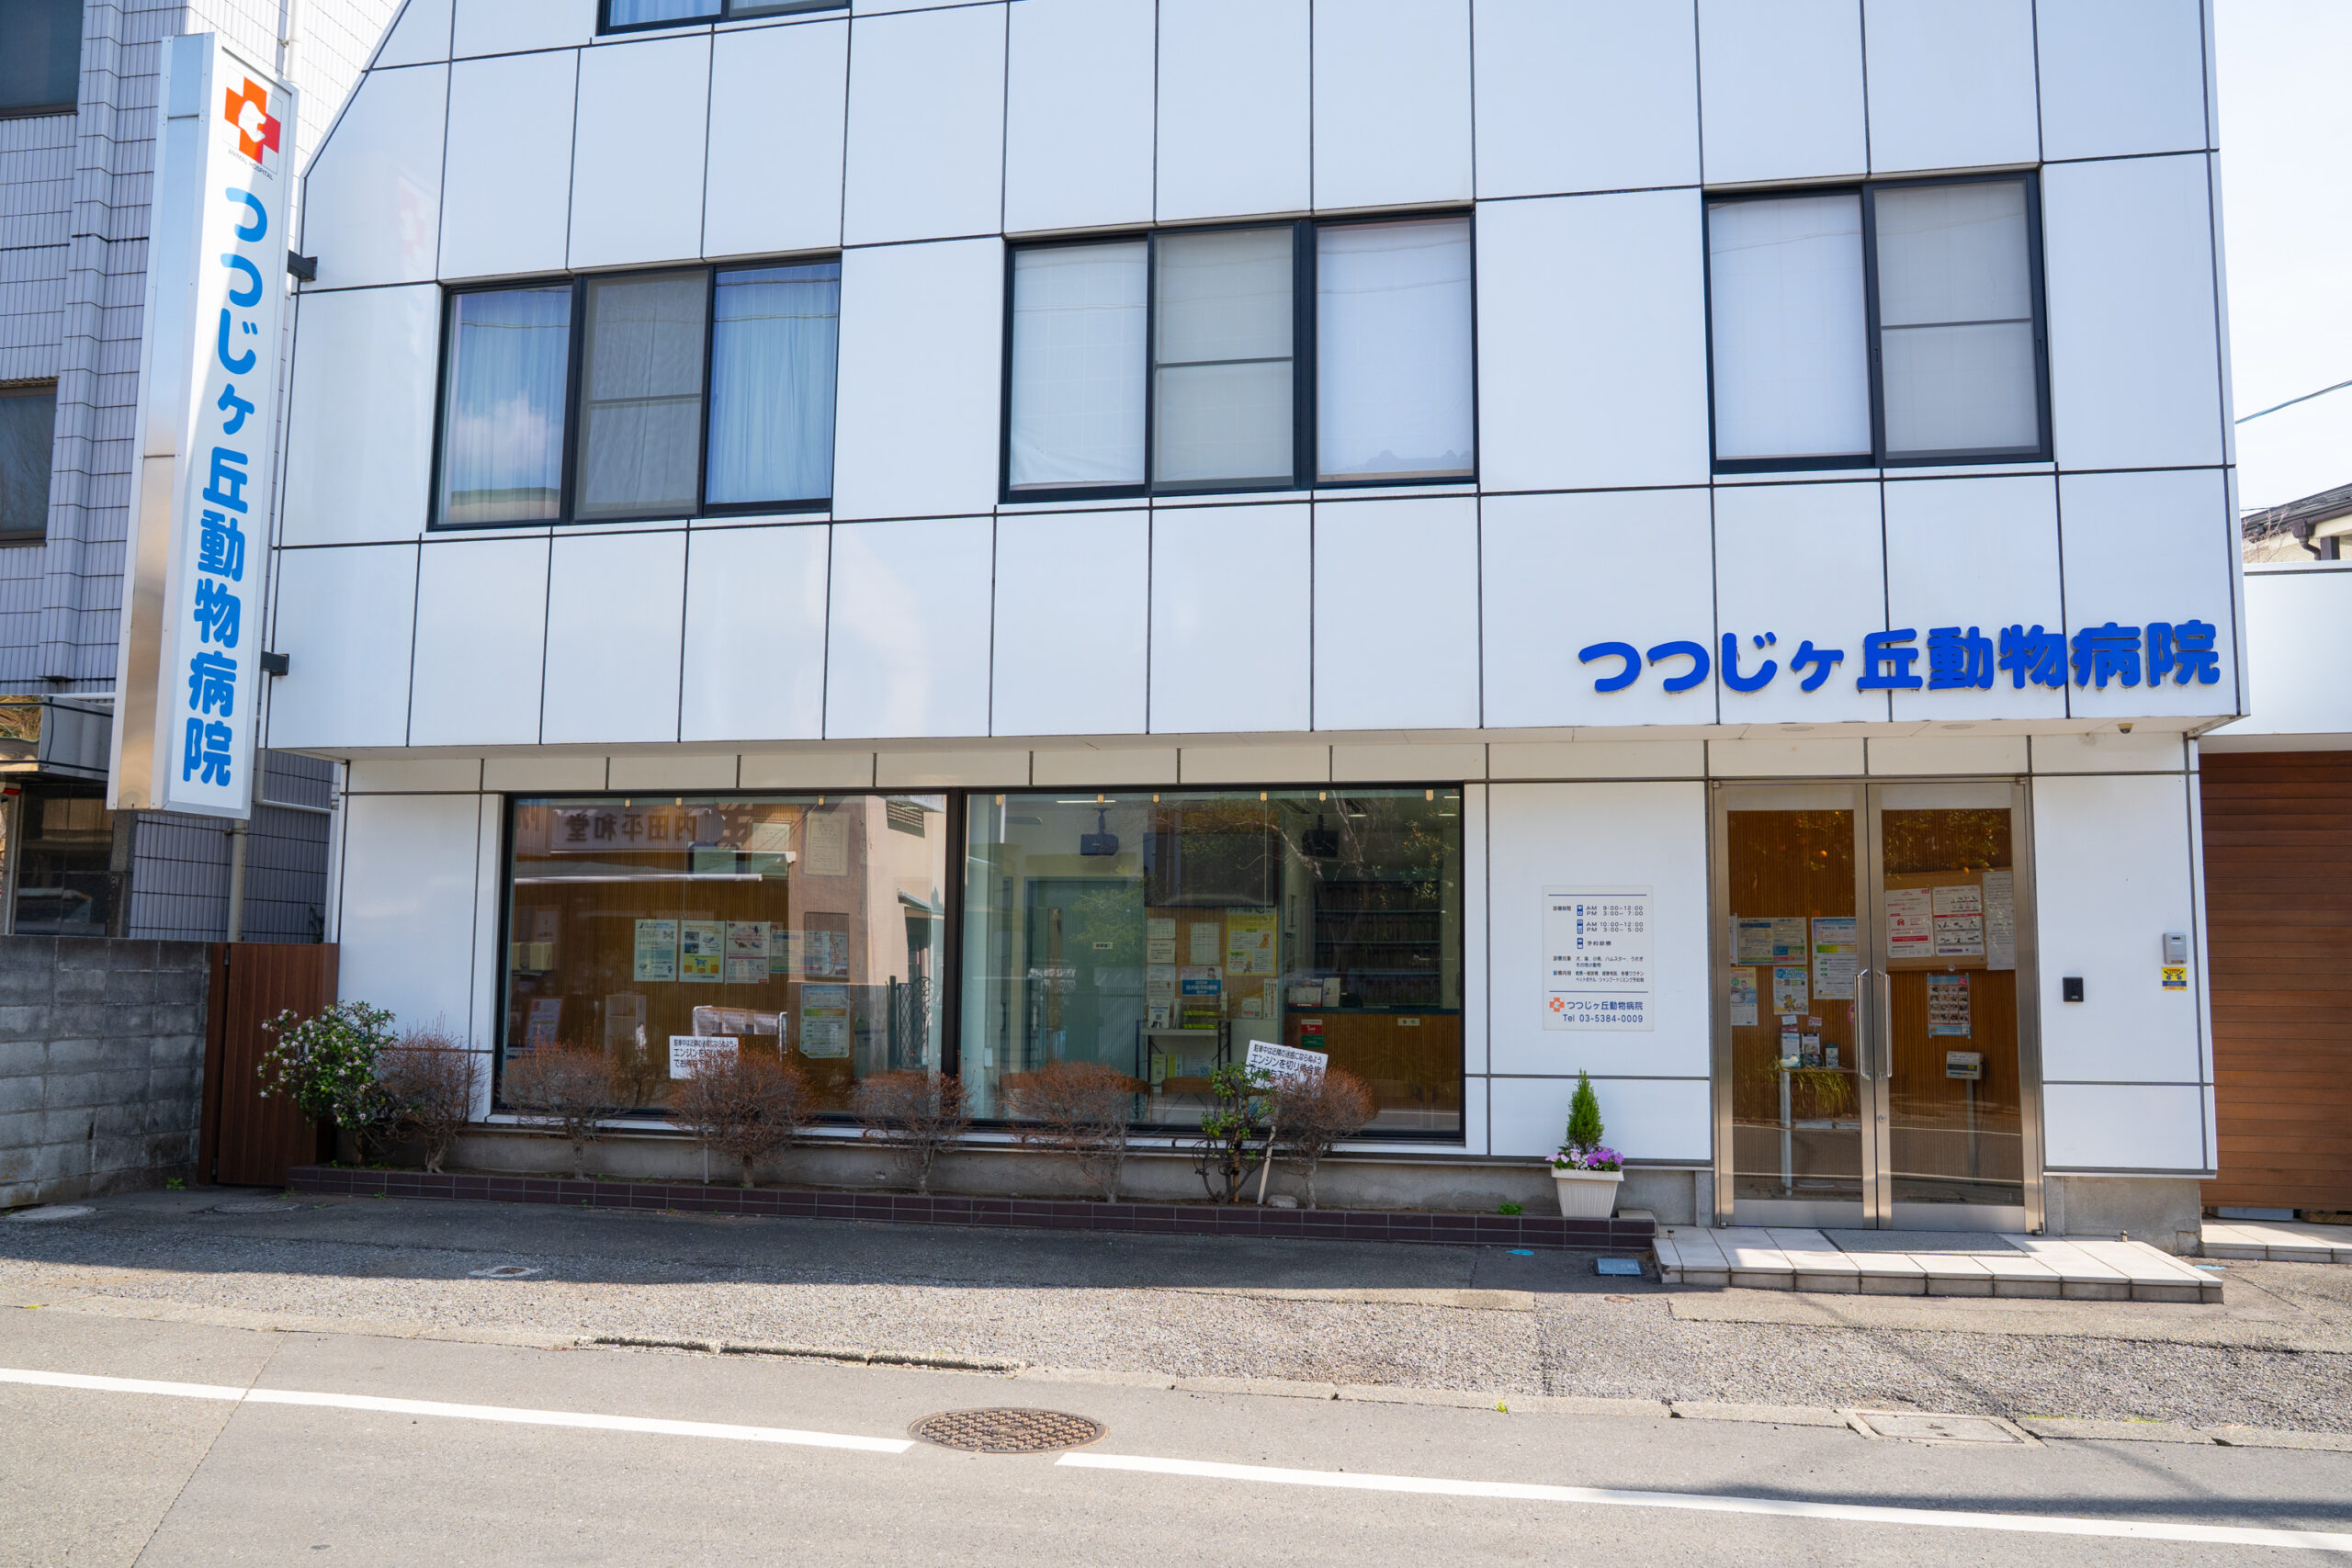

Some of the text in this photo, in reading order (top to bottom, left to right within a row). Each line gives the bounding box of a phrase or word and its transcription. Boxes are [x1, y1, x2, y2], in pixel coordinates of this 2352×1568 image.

[183, 187, 268, 787] つつじヶ丘動物病院
[1578, 619, 2221, 694] つつじヶ丘動物病院
[1566, 1001, 1644, 1010] つつじヶ丘動物病院
[1579, 1014, 1643, 1022] 03-5384-0009
